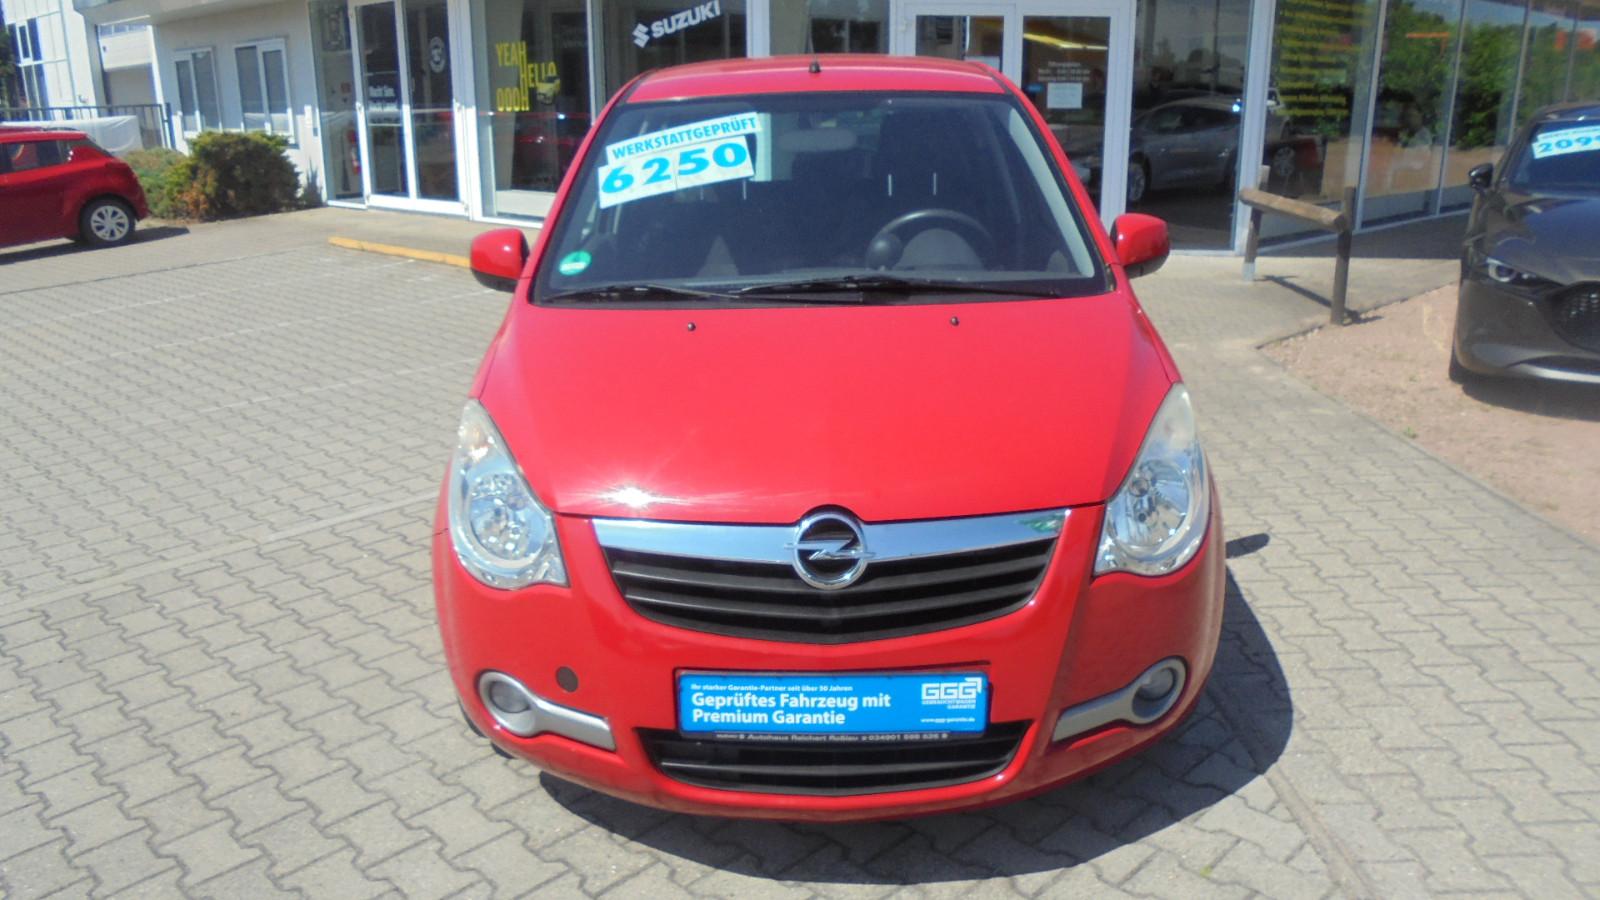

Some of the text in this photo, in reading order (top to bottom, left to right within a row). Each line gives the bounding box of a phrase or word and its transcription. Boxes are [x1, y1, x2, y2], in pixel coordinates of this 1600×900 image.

[651, 0, 720, 39] SUZUKI
[496, 41, 528, 67] YEAH
[611, 116, 757, 160] WERKSTATTGEPRÜFT
[601, 142, 748, 194] 6250
[692, 692, 891, 711] Geprüftes Fahrzeug mit
[922, 681, 977, 700] GGG
[692, 709, 846, 725] Premium Garantie
